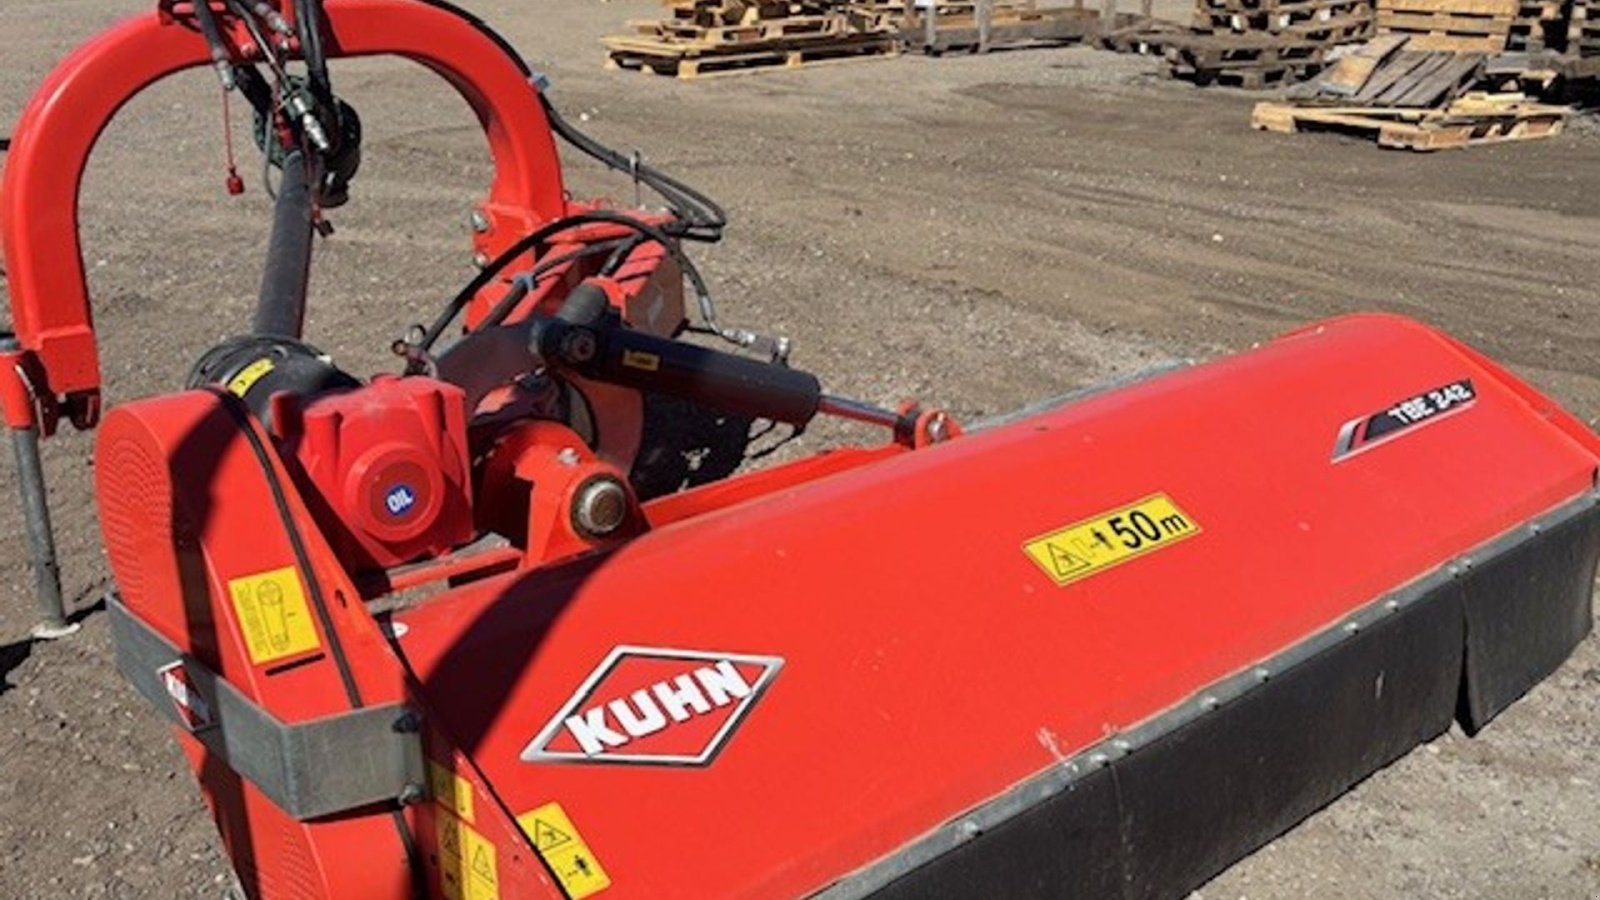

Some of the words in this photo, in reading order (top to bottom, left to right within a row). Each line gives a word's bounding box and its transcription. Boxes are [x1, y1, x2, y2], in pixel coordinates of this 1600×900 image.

[1387, 397, 1435, 424] TBE
[1428, 384, 1473, 409] 242
[387, 488, 413, 512] OIL
[564, 659, 753, 756] KUHN
